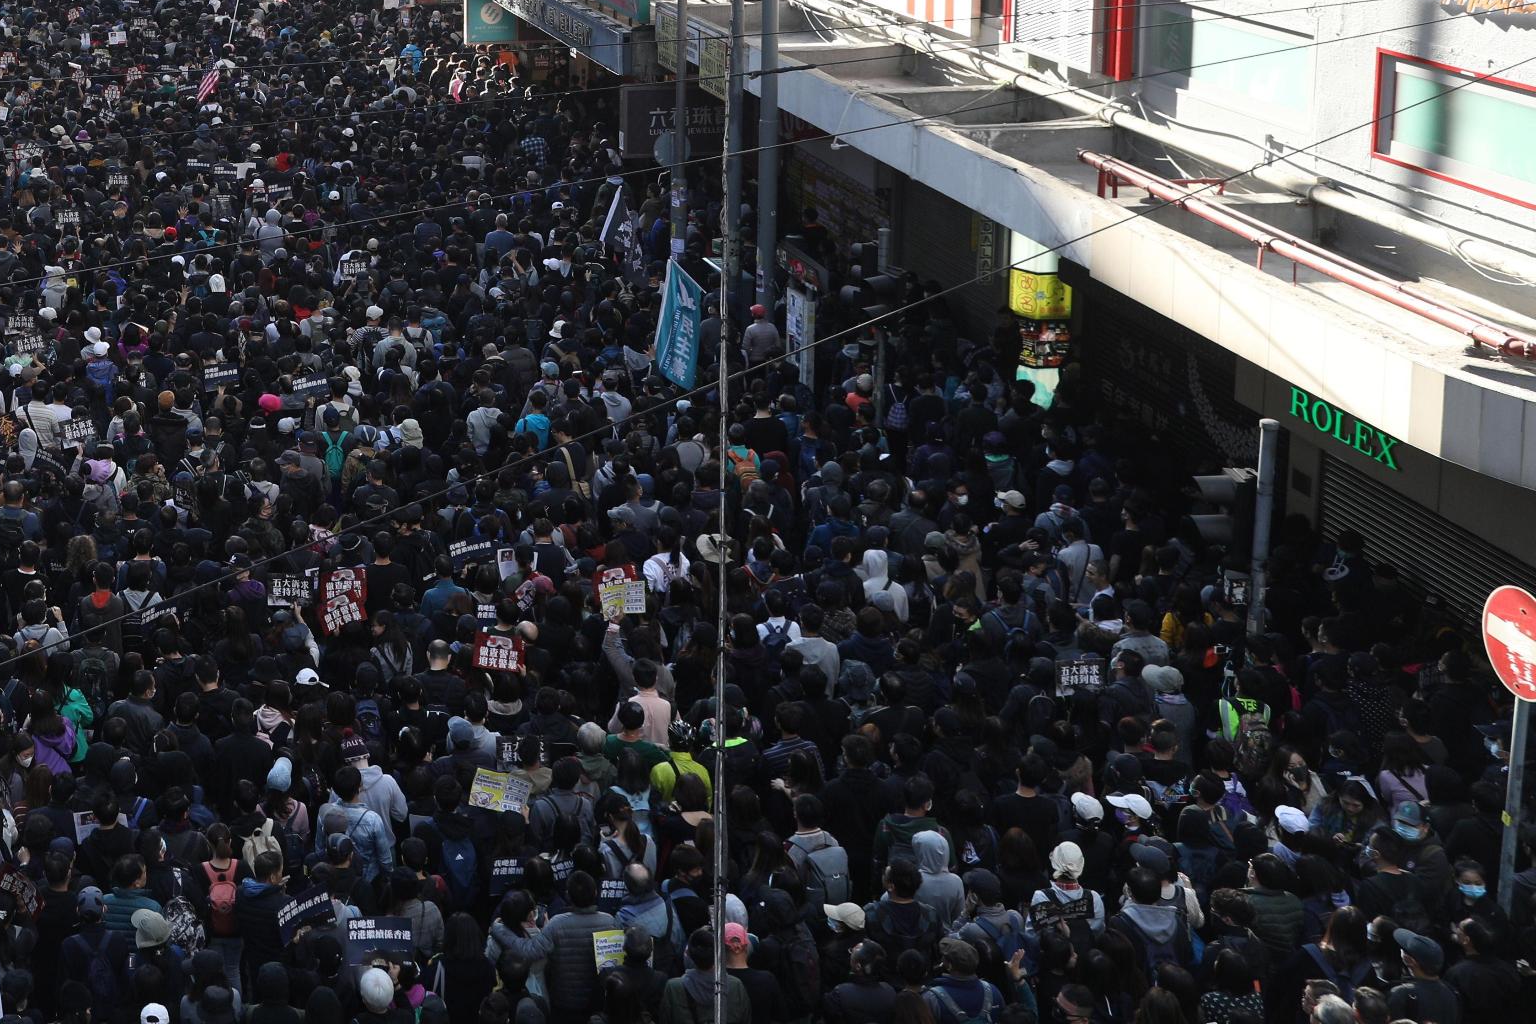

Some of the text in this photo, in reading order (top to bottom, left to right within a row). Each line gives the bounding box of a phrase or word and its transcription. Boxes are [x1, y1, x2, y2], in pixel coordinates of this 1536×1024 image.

[1289, 386, 1398, 472] ROLEX
[272, 578, 310, 589] 五大訴求
[272, 586, 310, 599] 堅持到底
[1061, 664, 1100, 675] 五大訴求
[1061, 674, 1100, 686] 堅持到底
[349, 919, 376, 929] 我哋想
[349, 929, 412, 941] 香港繼續係香港
